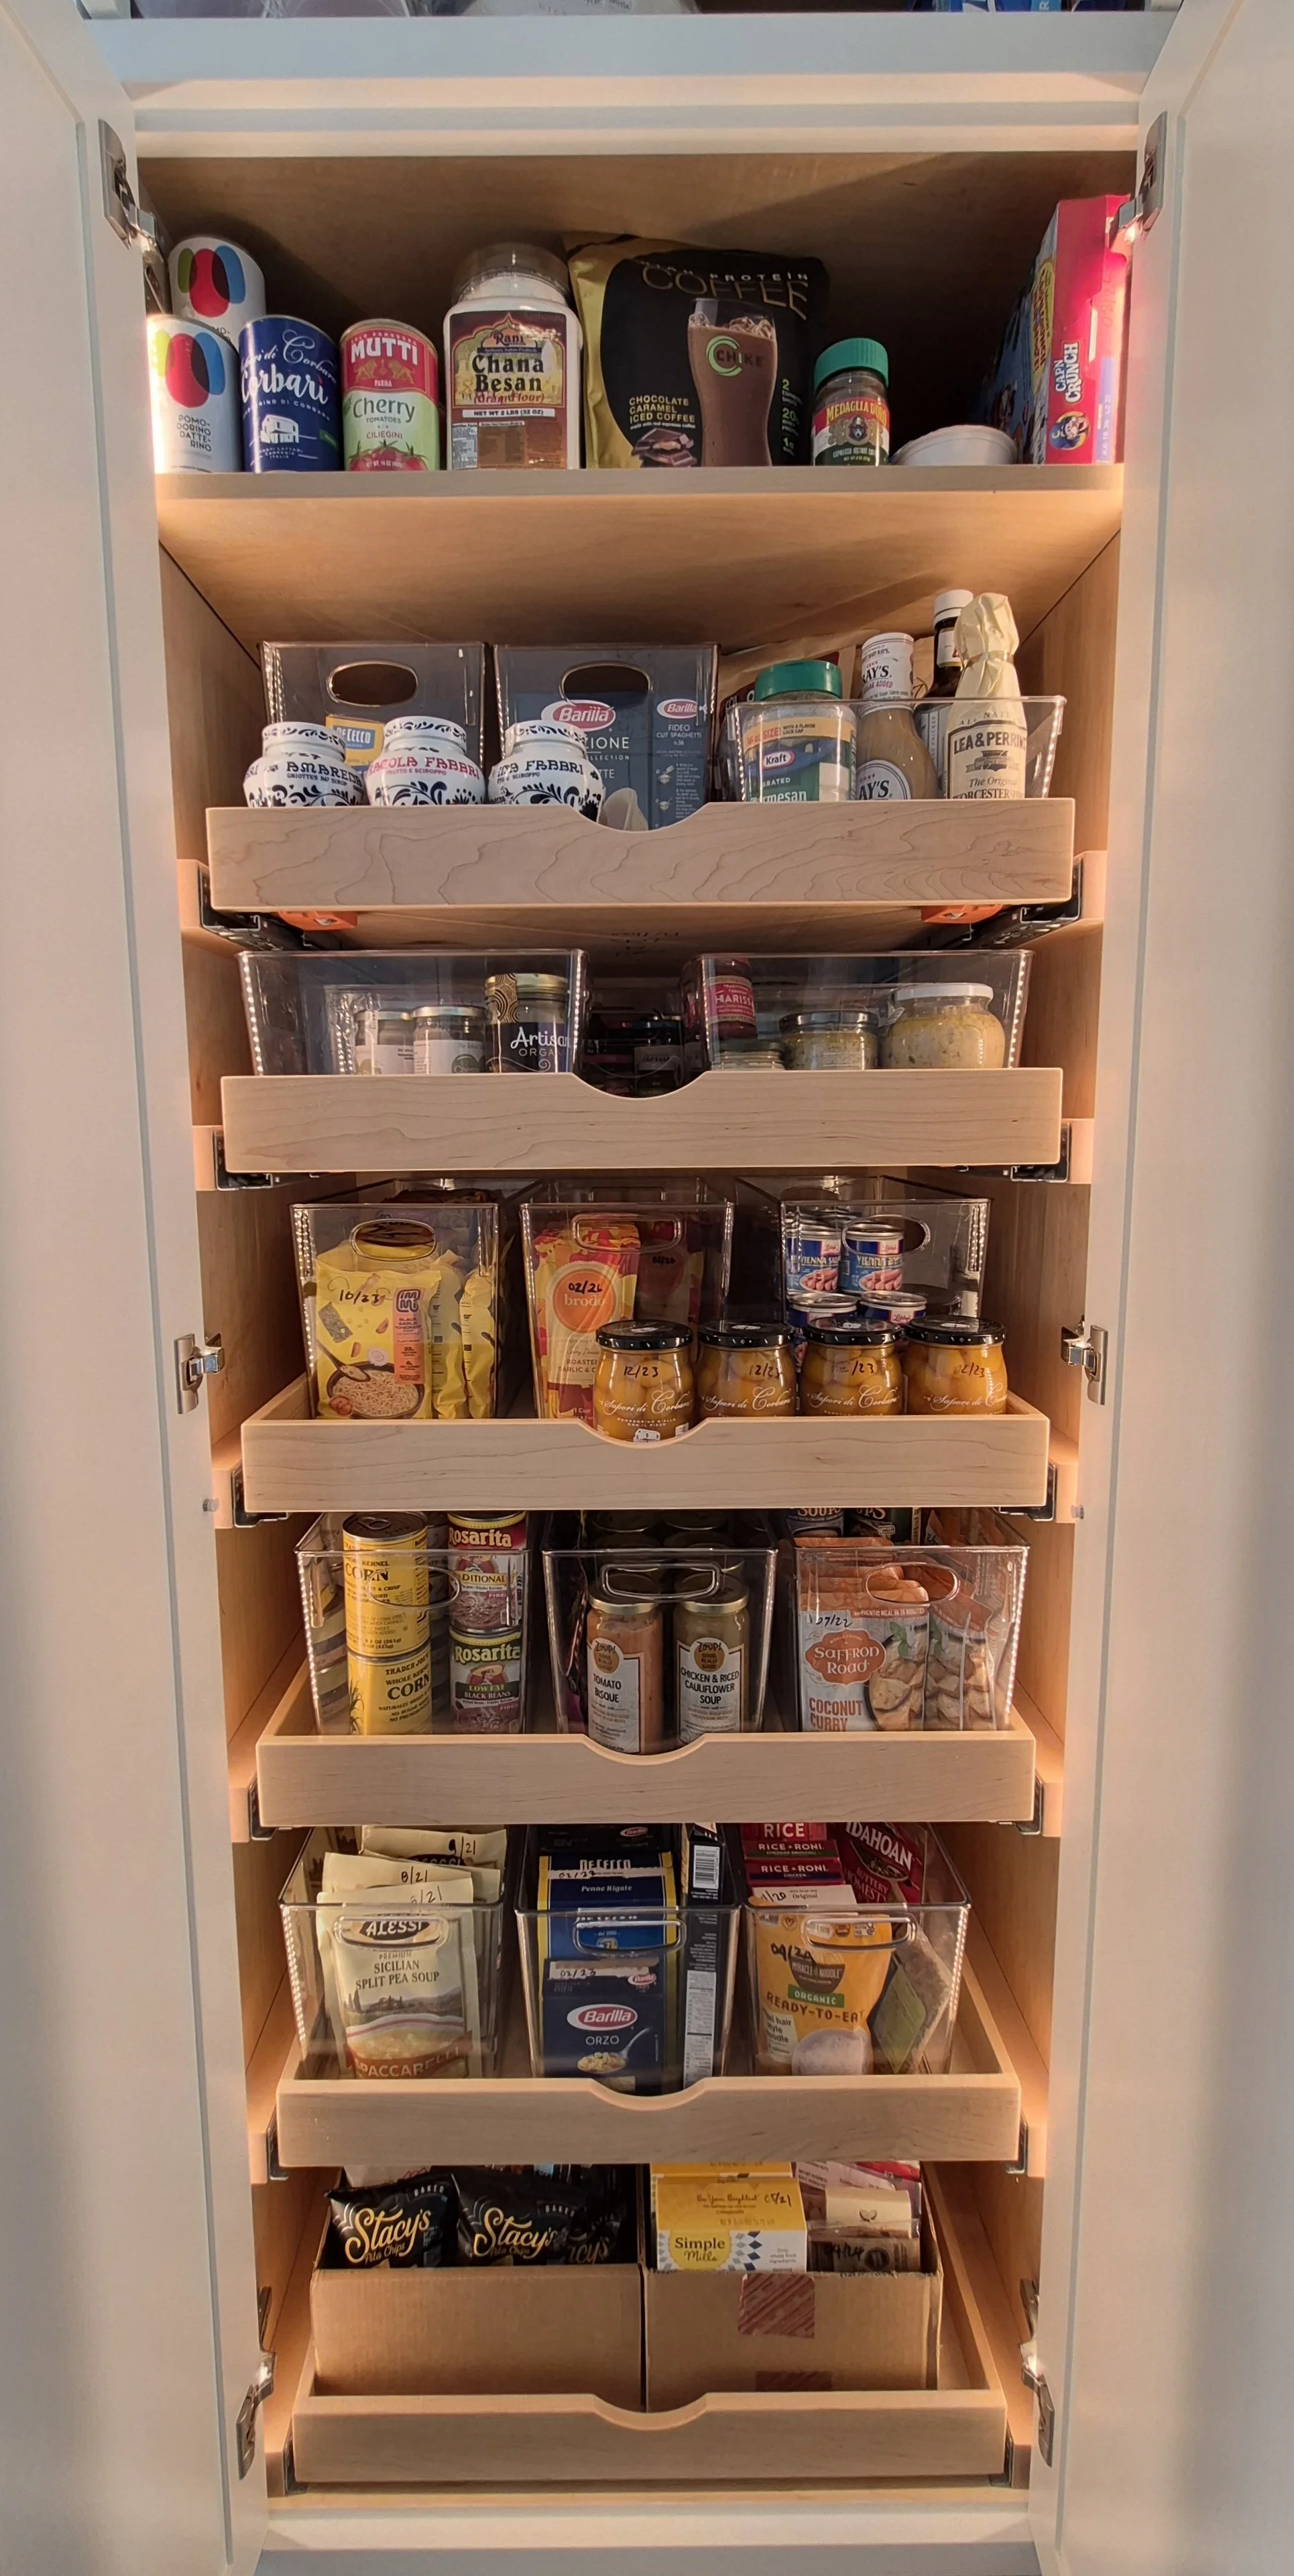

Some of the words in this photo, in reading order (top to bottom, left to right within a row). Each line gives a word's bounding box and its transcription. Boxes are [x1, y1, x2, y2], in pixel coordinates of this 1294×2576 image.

[351, 337, 418, 365] MUTTI
[472, 354, 544, 373] Chana
[716, 349, 763, 368] CHIKE
[1064, 342, 1082, 403] CRUNCH
[475, 374, 542, 392] Besan
[630, 395, 689, 406] CHOCOLATE
[353, 398, 415, 423] Cherry
[630, 404, 677, 415] CARAMEL
[827, 401, 869, 425] MEDAGLIA
[178, 414, 211, 426] POMO-
[630, 413, 653, 424] ICED
[657, 412, 695, 423] COFFEE
[176, 422, 211, 436] DORINO
[366, 430, 402, 440] CILIEGINI
[180, 430, 212, 443] DATTE-
[190, 440, 212, 452] RINO
[667, 703, 697, 713] Barilla
[558, 708, 608, 723] Barilla
[766, 754, 787, 765] Kraft
[425, 756, 480, 780] FABBRI
[525, 760, 584, 775] FABBRI
[859, 780, 890, 800] AY'S
[969, 778, 985, 788] The
[564, 1295, 605, 1307] brodo
[603, 1399, 636, 1415] Sapori
[636, 1401, 646, 1412] di
[738, 1398, 749, 1409] di
[843, 1396, 854, 1406] di
[972, 1396, 982, 1406] di
[449, 1527, 512, 1547] Rosarita
[345, 1563, 388, 1581] CORN
[455, 1643, 520, 1664] Rosarita
[385, 1662, 415, 1675] TRADER
[827, 1661, 870, 1674] Road
[386, 1674, 411, 1685] WHOLE
[593, 1674, 622, 1690] TOMATO
[681, 1667, 710, 1683] CHICKEN
[712, 1675, 718, 1683] &
[720, 1671, 740, 1682] RICED
[388, 1673, 429, 1700] CORN
[685, 1680, 735, 1694] CAULIFLOWER
[595, 1687, 619, 1703] BISQUE
[700, 1695, 721, 1704] SOUP
[378, 1701, 408, 1711] NATURALLY
[809, 1697, 863, 1716] COCONUT
[810, 1715, 848, 1731] CURRY
[764, 1822, 805, 1837] RICE
[845, 1822, 913, 1871] IDAHOAN
[366, 1920, 422, 1936] ALESSI
[374, 1960, 420, 1974] SICILIAN
[819, 1968, 840, 1979] NOODLE
[355, 1975, 385, 1990] SPLIT
[389, 1974, 409, 1985] PEA
[412, 1971, 440, 1983] SOUP
[795, 1991, 837, 2005] ORGANIC
[584, 2011, 631, 2024] Barilla
[776, 2016, 792, 2026] hair
[585, 2036, 620, 2045] ORZO
[414, 2184, 445, 2197] BAKED
[345, 2207, 431, 2265] Stacy's
[473, 2206, 556, 2259] Stacy's
[674, 2237, 725, 2250] Simple
[684, 2250, 719, 2262] Mills
